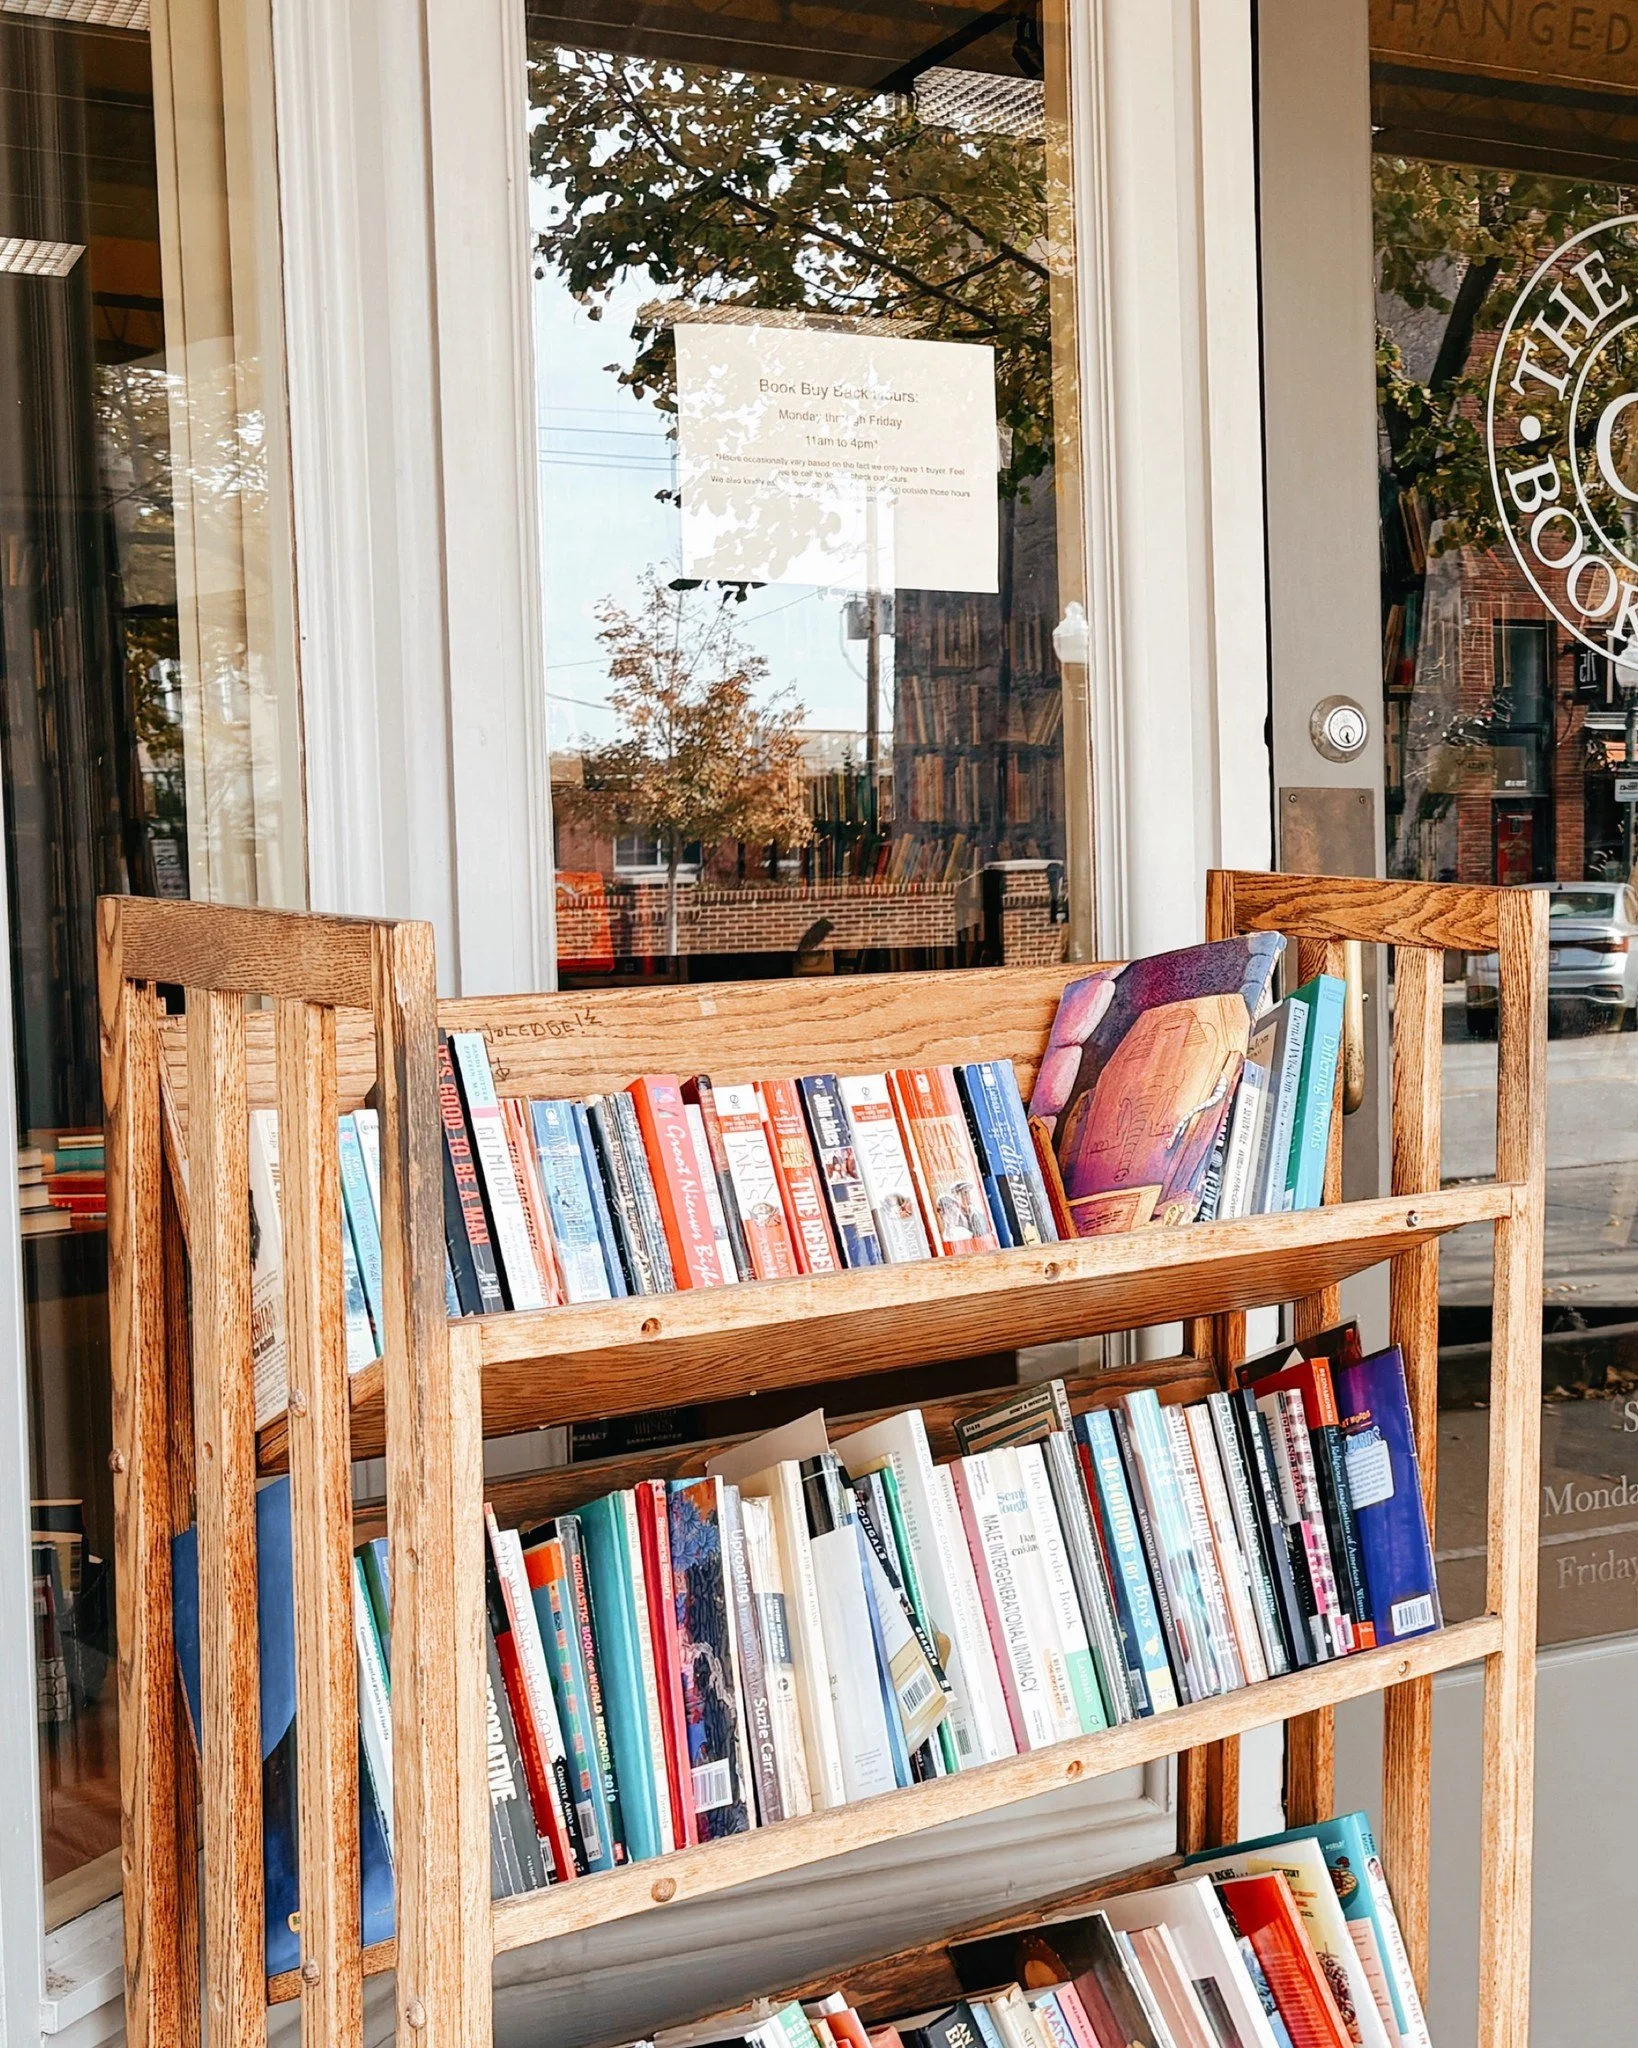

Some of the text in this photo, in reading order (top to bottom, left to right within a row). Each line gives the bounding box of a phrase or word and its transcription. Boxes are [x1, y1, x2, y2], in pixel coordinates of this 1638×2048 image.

[1510, 249, 1628, 401] THE
[759, 379, 796, 394] Book
[801, 382, 829, 400] Buy
[873, 390, 919, 403] urs:
[806, 435, 834, 446] 11am
[837, 436, 848, 448] to
[825, 411, 866, 427] thrgh
[869, 415, 902, 429] Friday
[1279, 1004, 1309, 1093] Eternal Wisdom
[1304, 1032, 1339, 1150] Differing Visions
[811, 1090, 846, 1147] John Jakes
[436, 1043, 489, 1246] IT'S GOOD TO BE A MAN
[871, 1124, 913, 1188] JOHN
[744, 1135, 778, 1199] JOHN
[661, 1122, 695, 1177] Groot
[686, 1241, 722, 1289] Bijbe
[788, 1175, 835, 1273] THE REBE
[1284, 1440, 1297, 1462] AND
[1325, 1426, 1339, 1443] The
[1025, 1460, 1046, 1490] The
[1216, 1400, 1260, 1559] Deborah Nicholson
[1326, 1443, 1346, 1482] Religious
[1032, 1494, 1057, 1534] Birth
[1334, 1482, 1355, 1533] Imagination
[1543, 1475, 1638, 1518] Monda
[980, 1513, 1003, 1541] MALE
[1099, 1456, 1138, 1554] Devotions
[1130, 1581, 1153, 1630] Boys
[655, 1516, 673, 1601] Sleeping Beauty
[729, 1527, 752, 1604] Uprooting
[1043, 1536, 1070, 1584] Order
[1139, 1514, 1158, 1559] DIALOGUE
[1153, 1569, 1175, 1632] CIVILIZATIONS
[1345, 1544, 1365, 1586] American
[568, 1553, 591, 1623] SCHOLASTIC
[987, 1541, 1027, 1643] INTERGENERATIONAL
[1055, 1589, 1082, 1629] Book
[1261, 1574, 1279, 1614] FLIRTING
[1351, 1585, 1370, 1621] Women
[579, 1624, 596, 1657] BOOK
[911, 1625, 940, 1666] GRAHAM
[1011, 1643, 1039, 1693] INTIMACY
[587, 1672, 605, 1714] WORLD
[486, 1670, 539, 1806] ORATIVE
[535, 1708, 557, 1751] GOD
[751, 1696, 771, 1737] Suzie
[593, 1714, 613, 1770] RECORDS
[758, 1742, 777, 1775] Carr
[602, 1771, 620, 1801] 2010
[1407, 1993, 1422, 2026] CHEF
